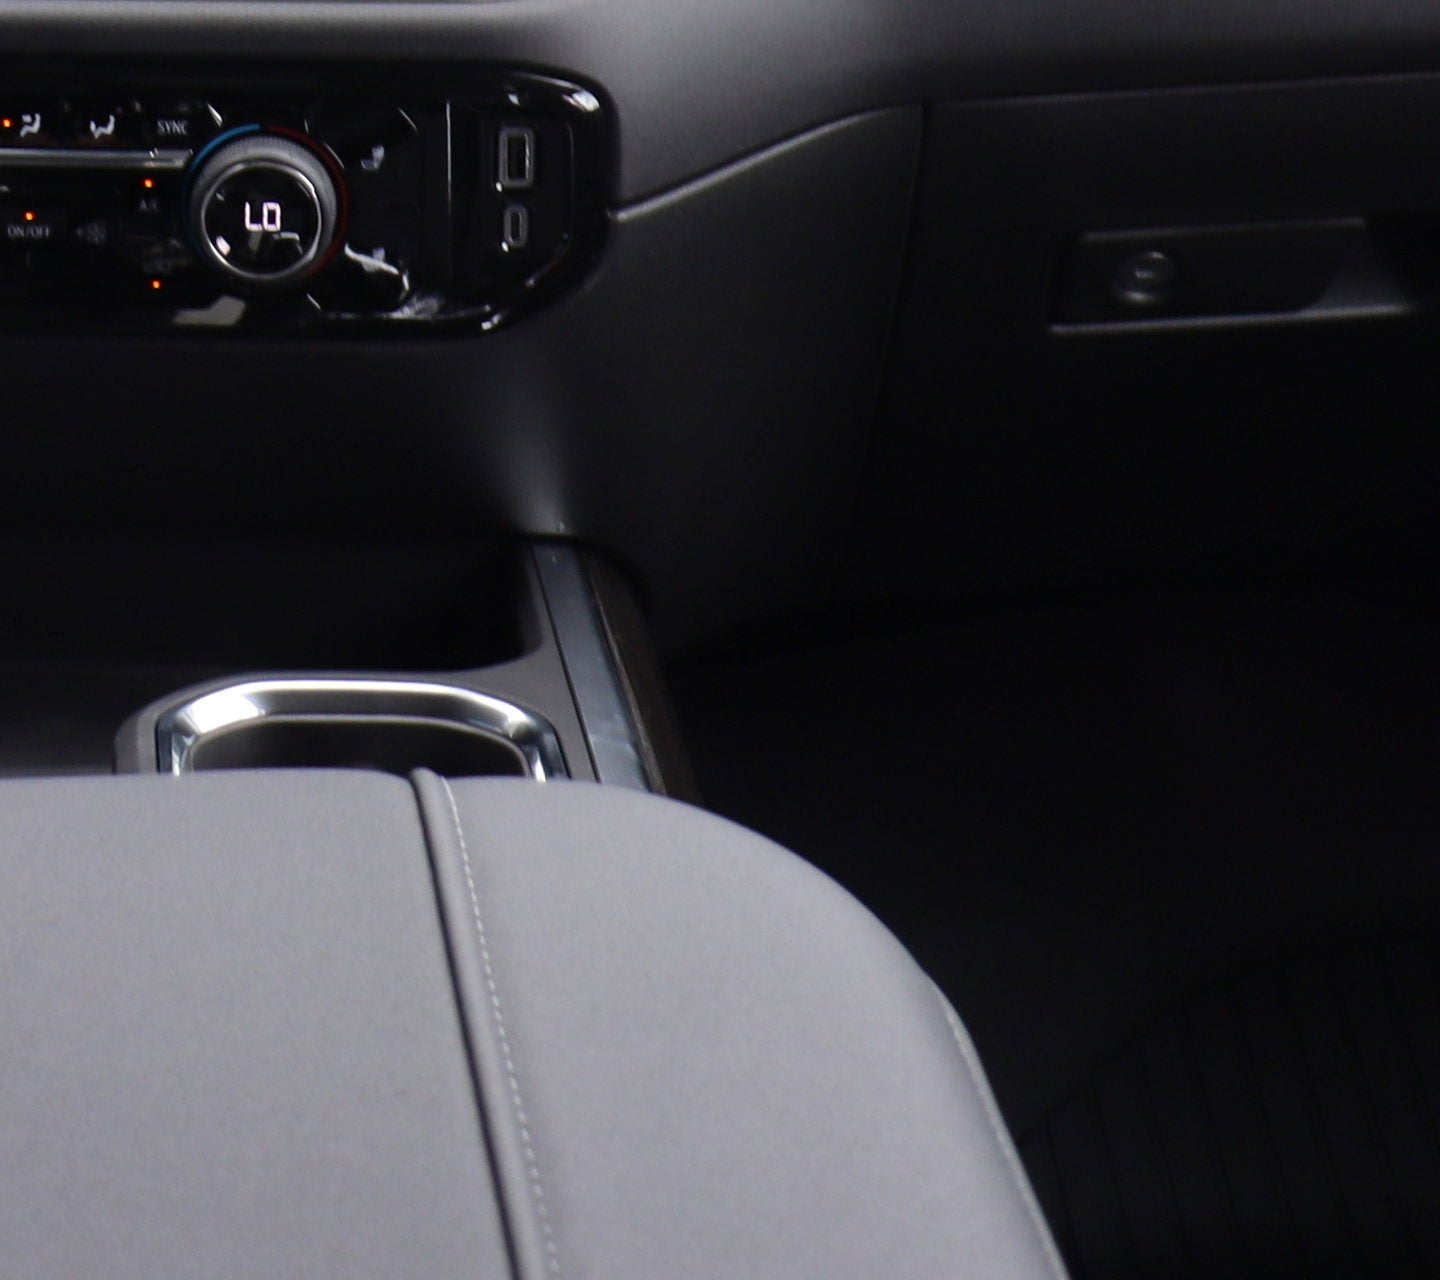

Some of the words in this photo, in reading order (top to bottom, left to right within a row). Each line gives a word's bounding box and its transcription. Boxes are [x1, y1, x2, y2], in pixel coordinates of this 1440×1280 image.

[157, 119, 188, 134] SYNC
[244, 201, 281, 232] LO
[6, 225, 51, 238] ON/OFF
